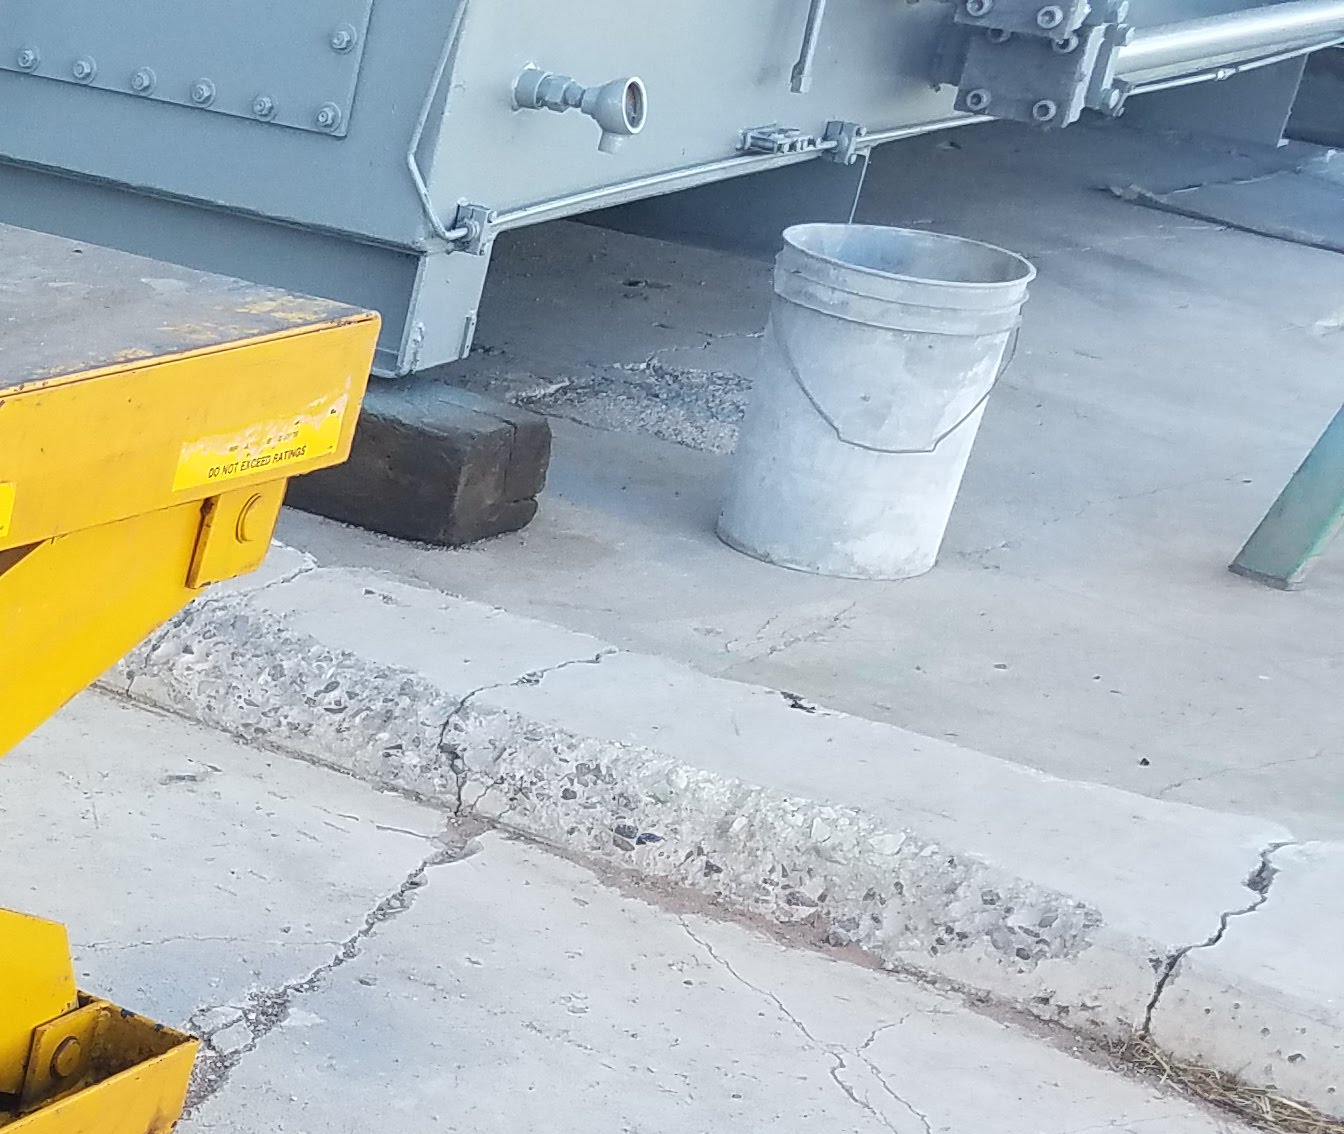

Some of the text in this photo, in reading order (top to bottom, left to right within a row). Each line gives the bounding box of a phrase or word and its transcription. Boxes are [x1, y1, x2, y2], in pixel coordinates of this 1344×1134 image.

[208, 446, 307, 479] DO NOT EXCEED RATINGS
